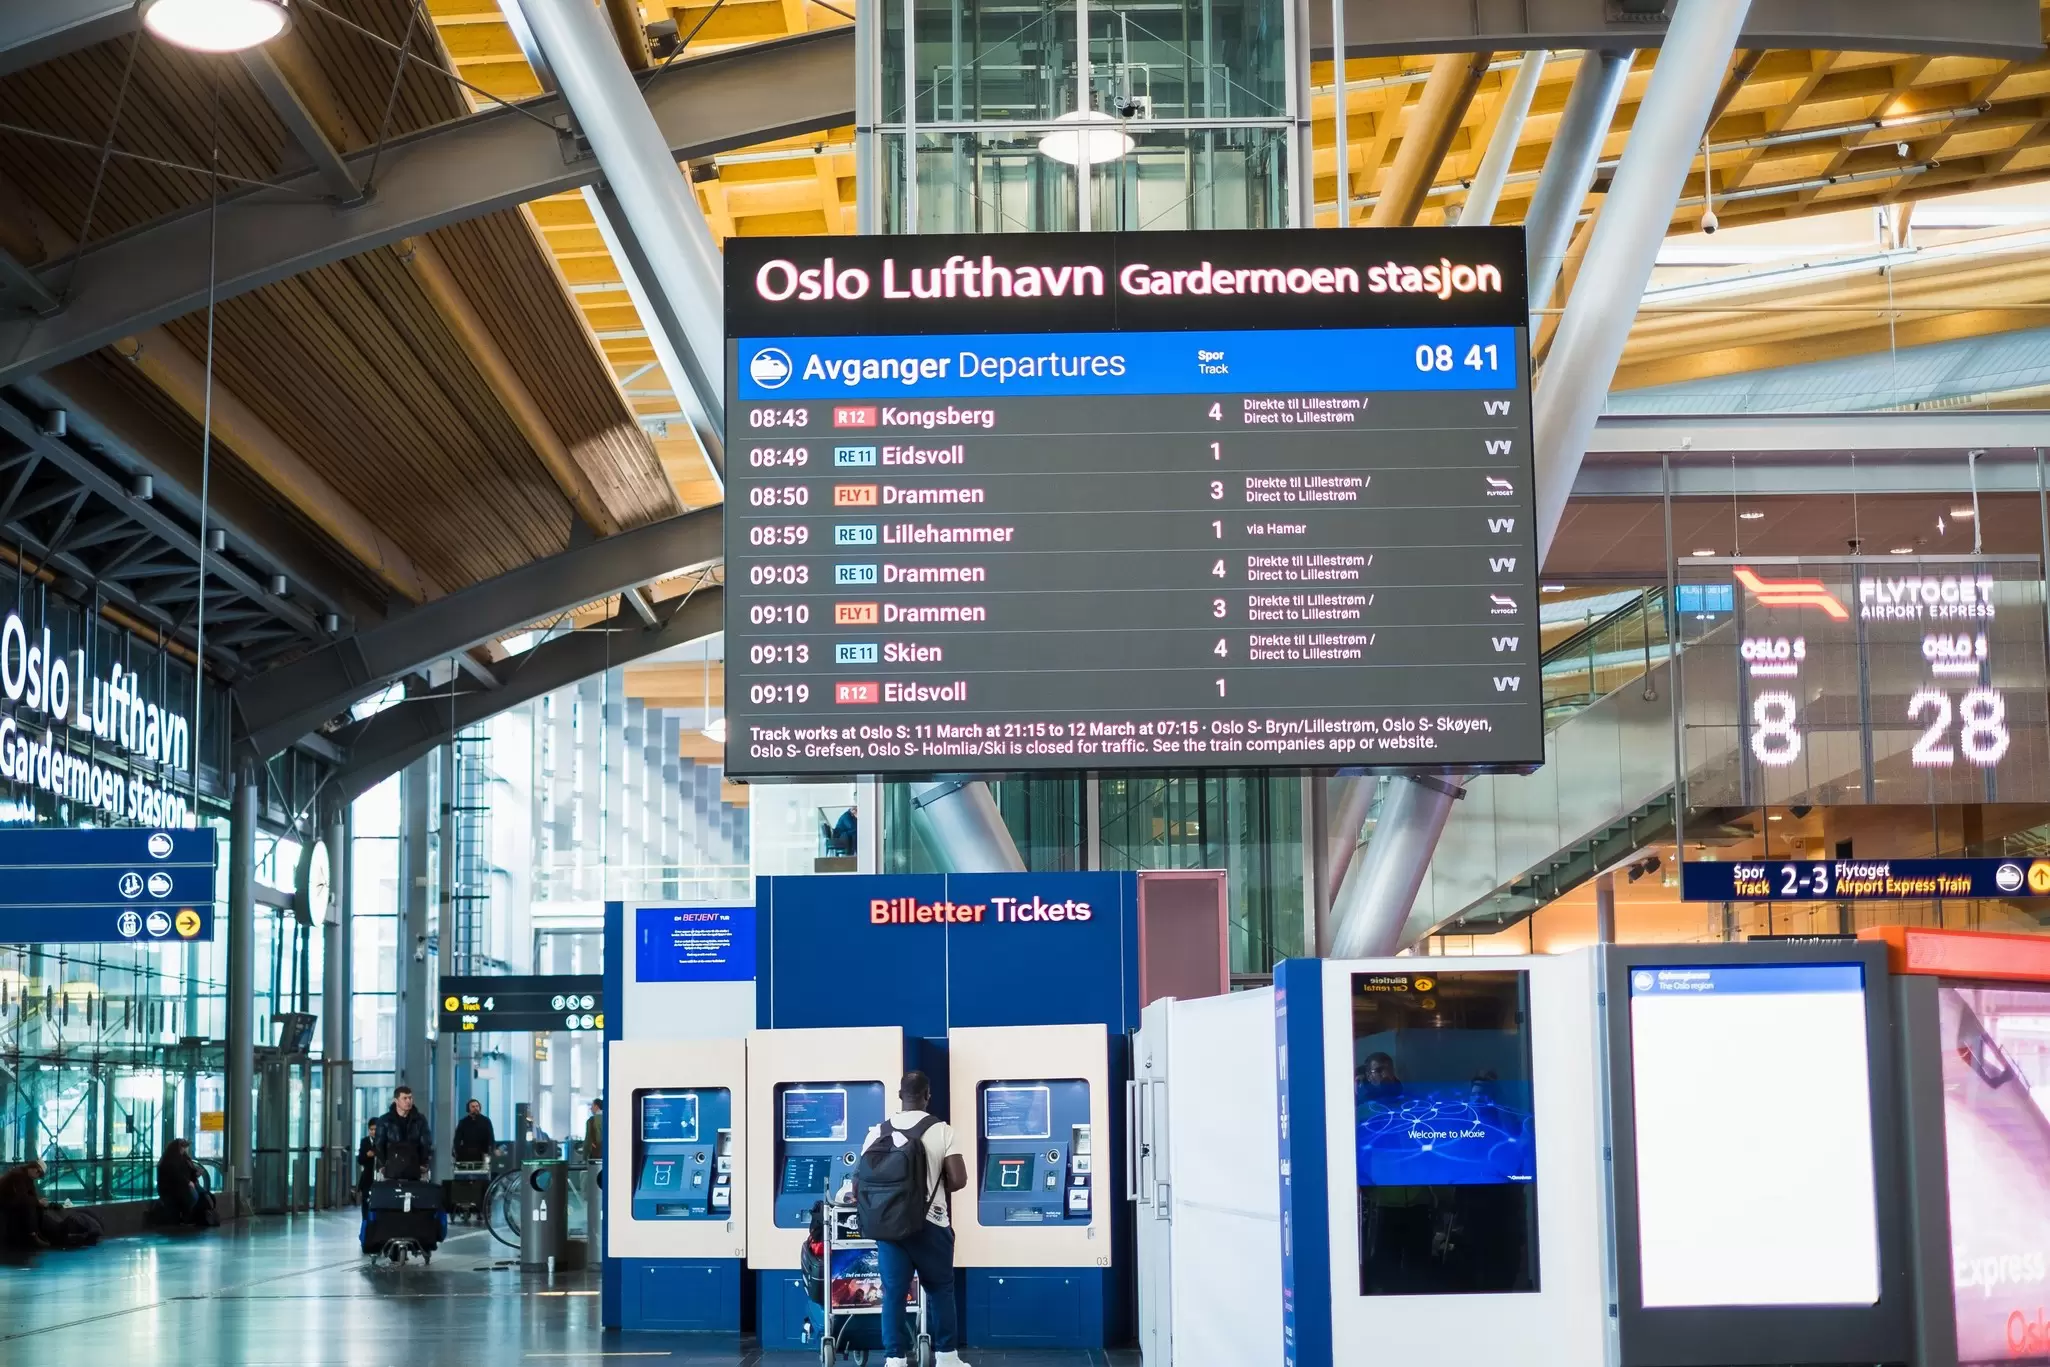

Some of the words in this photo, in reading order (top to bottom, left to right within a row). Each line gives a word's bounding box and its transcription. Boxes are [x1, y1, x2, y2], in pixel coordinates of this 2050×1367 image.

[756, 258, 869, 300] Oslo
[883, 255, 1103, 298] Lufthavn
[1120, 261, 1359, 295] Gardermoen
[1368, 258, 1501, 299] stasjon
[803, 353, 950, 385] Avganger
[959, 351, 1126, 383] Departures
[1198, 350, 1224, 363] Spor
[1199, 364, 1228, 375] Track
[1244, 399, 1285, 409] Direkte
[1288, 399, 1299, 409] til
[1302, 398, 1359, 409] Lillestrøm
[750, 408, 808, 427] 08:43
[882, 406, 994, 429] Kongsberg
[1208, 403, 1222, 421] 4
[1244, 413, 1278, 423] Direct
[1282, 413, 1293, 423] to
[1297, 412, 1354, 422] Lillestrøm
[750, 448, 808, 467] 08:49
[882, 445, 964, 465] Eidsvoll
[1210, 442, 1220, 460] 1
[750, 487, 808, 506] 08:50
[883, 486, 984, 504] Drammen
[1210, 481, 1224, 499] 3
[1246, 478, 1287, 488] Direkte
[1290, 477, 1300, 488] til
[1304, 476, 1362, 487] Lillestrøm
[1247, 492, 1280, 501] Direct
[1284, 492, 1295, 501] to
[1299, 490, 1356, 501] Lillestrøm
[750, 526, 808, 545] 08:59
[883, 524, 1014, 543] Lillehammer
[1212, 520, 1222, 539] 1
[1247, 524, 1264, 534] via
[1267, 524, 1306, 534] Hamar
[750, 566, 809, 585] 09:03
[884, 565, 985, 582] Drammen
[1212, 559, 1226, 578] 4
[1248, 556, 1289, 566] Direkte
[1292, 556, 1303, 566] til
[1306, 555, 1364, 566] Lillestrøm
[1248, 570, 1283, 580] Direct
[1286, 570, 1297, 580] to
[1301, 569, 1359, 579] Lillestrøm
[1249, 596, 1290, 606] Direkte
[1293, 595, 1303, 606] til
[1307, 594, 1365, 605] Lillestrøm
[1860, 575, 1994, 606] FLYTOGET
[750, 605, 809, 624] 09:10
[884, 604, 985, 622] Drammen
[1213, 599, 1226, 618] 3
[1249, 610, 1283, 620] Direct
[1287, 610, 1298, 619] to
[1302, 609, 1360, 619] Lillestrøm
[1861, 605, 1923, 620] AIRPORT
[1929, 604, 1995, 618] EXPRESS
[750, 645, 809, 664] 09:13
[884, 643, 942, 662] Skien
[1214, 639, 1228, 657] 4
[1250, 635, 1291, 646] Direkte
[1294, 635, 1305, 645] til
[1309, 634, 1366, 645] Lillestrøm
[1741, 638, 1790, 660] OSLO
[1794, 636, 1805, 660] S
[1922, 634, 1972, 659] OSLO
[1975, 634, 1988, 659] S
[1250, 650, 1284, 660] Direct
[1288, 650, 1299, 659] to
[1303, 648, 1361, 659] Lillestrøm
[1, 614, 69, 720] Oslo
[76, 648, 189, 771] Lufthavn
[751, 684, 809, 704] 09:19
[884, 682, 966, 702] Eidsvoll
[1216, 679, 1226, 697] 1
[750, 727, 790, 740] Track
[794, 726, 837, 740] works
[841, 727, 855, 739] at
[860, 726, 892, 739] Oslo
[896, 725, 910, 739] S:
[915, 725, 931, 738] 11
[937, 724, 982, 738] March
[986, 726, 1000, 737] at
[1004, 724, 1045, 737] 21:15
[1049, 724, 1063, 736] to
[1068, 723, 1085, 736] 12
[1090, 722, 1135, 736] March
[1139, 722, 1153, 735] at
[1157, 721, 1198, 735] 07:15
[1211, 721, 1243, 734] Oslo
[1248, 720, 1261, 733] S-
[1383, 718, 1415, 731] Oslo
[1419, 717, 1433, 731] S-
[1437, 716, 1492, 734] Skøyen,
[1752, 690, 1801, 766] 8
[1908, 687, 2010, 767] 28
[750, 744, 782, 758] Oslo
[787, 744, 801, 757] S-
[805, 743, 863, 758] Grefsen,
[868, 742, 900, 756] Oslo
[905, 743, 918, 755] S-
[923, 740, 1005, 756] Holmlia/Ski
[1010, 742, 1021, 754] is
[1026, 740, 1073, 754] closed
[1077, 739, 1098, 753] for
[1101, 739, 1148, 753] traffic.
[1153, 739, 1179, 752] See
[1183, 739, 1206, 751] the
[1210, 738, 1242, 751] train
[1246, 737, 1324, 753] companies
[1330, 739, 1355, 752] app
[1360, 738, 1375, 749] or
[1378, 736, 1437, 749] website.
[0, 717, 125, 815] Gardermoen
[1734, 865, 1764, 879] Spor
[1781, 866, 1829, 894] 2-3
[1835, 863, 1889, 879] Flytoget
[1734, 880, 1769, 895] Track
[1836, 878, 1883, 896] Airport
[1886, 878, 1935, 896] Express
[1937, 877, 1971, 894] Train
[870, 898, 985, 924] Billetter
[991, 896, 1092, 922] Tickets
[1691, 983, 1714, 992] region
[484, 997, 494, 1011] 4
[1460, 1130, 1485, 1138] Moxie
[735, 1248, 744, 1256] 01
[1097, 1257, 1108, 1265] 03
[1955, 1252, 2044, 1297] Express
